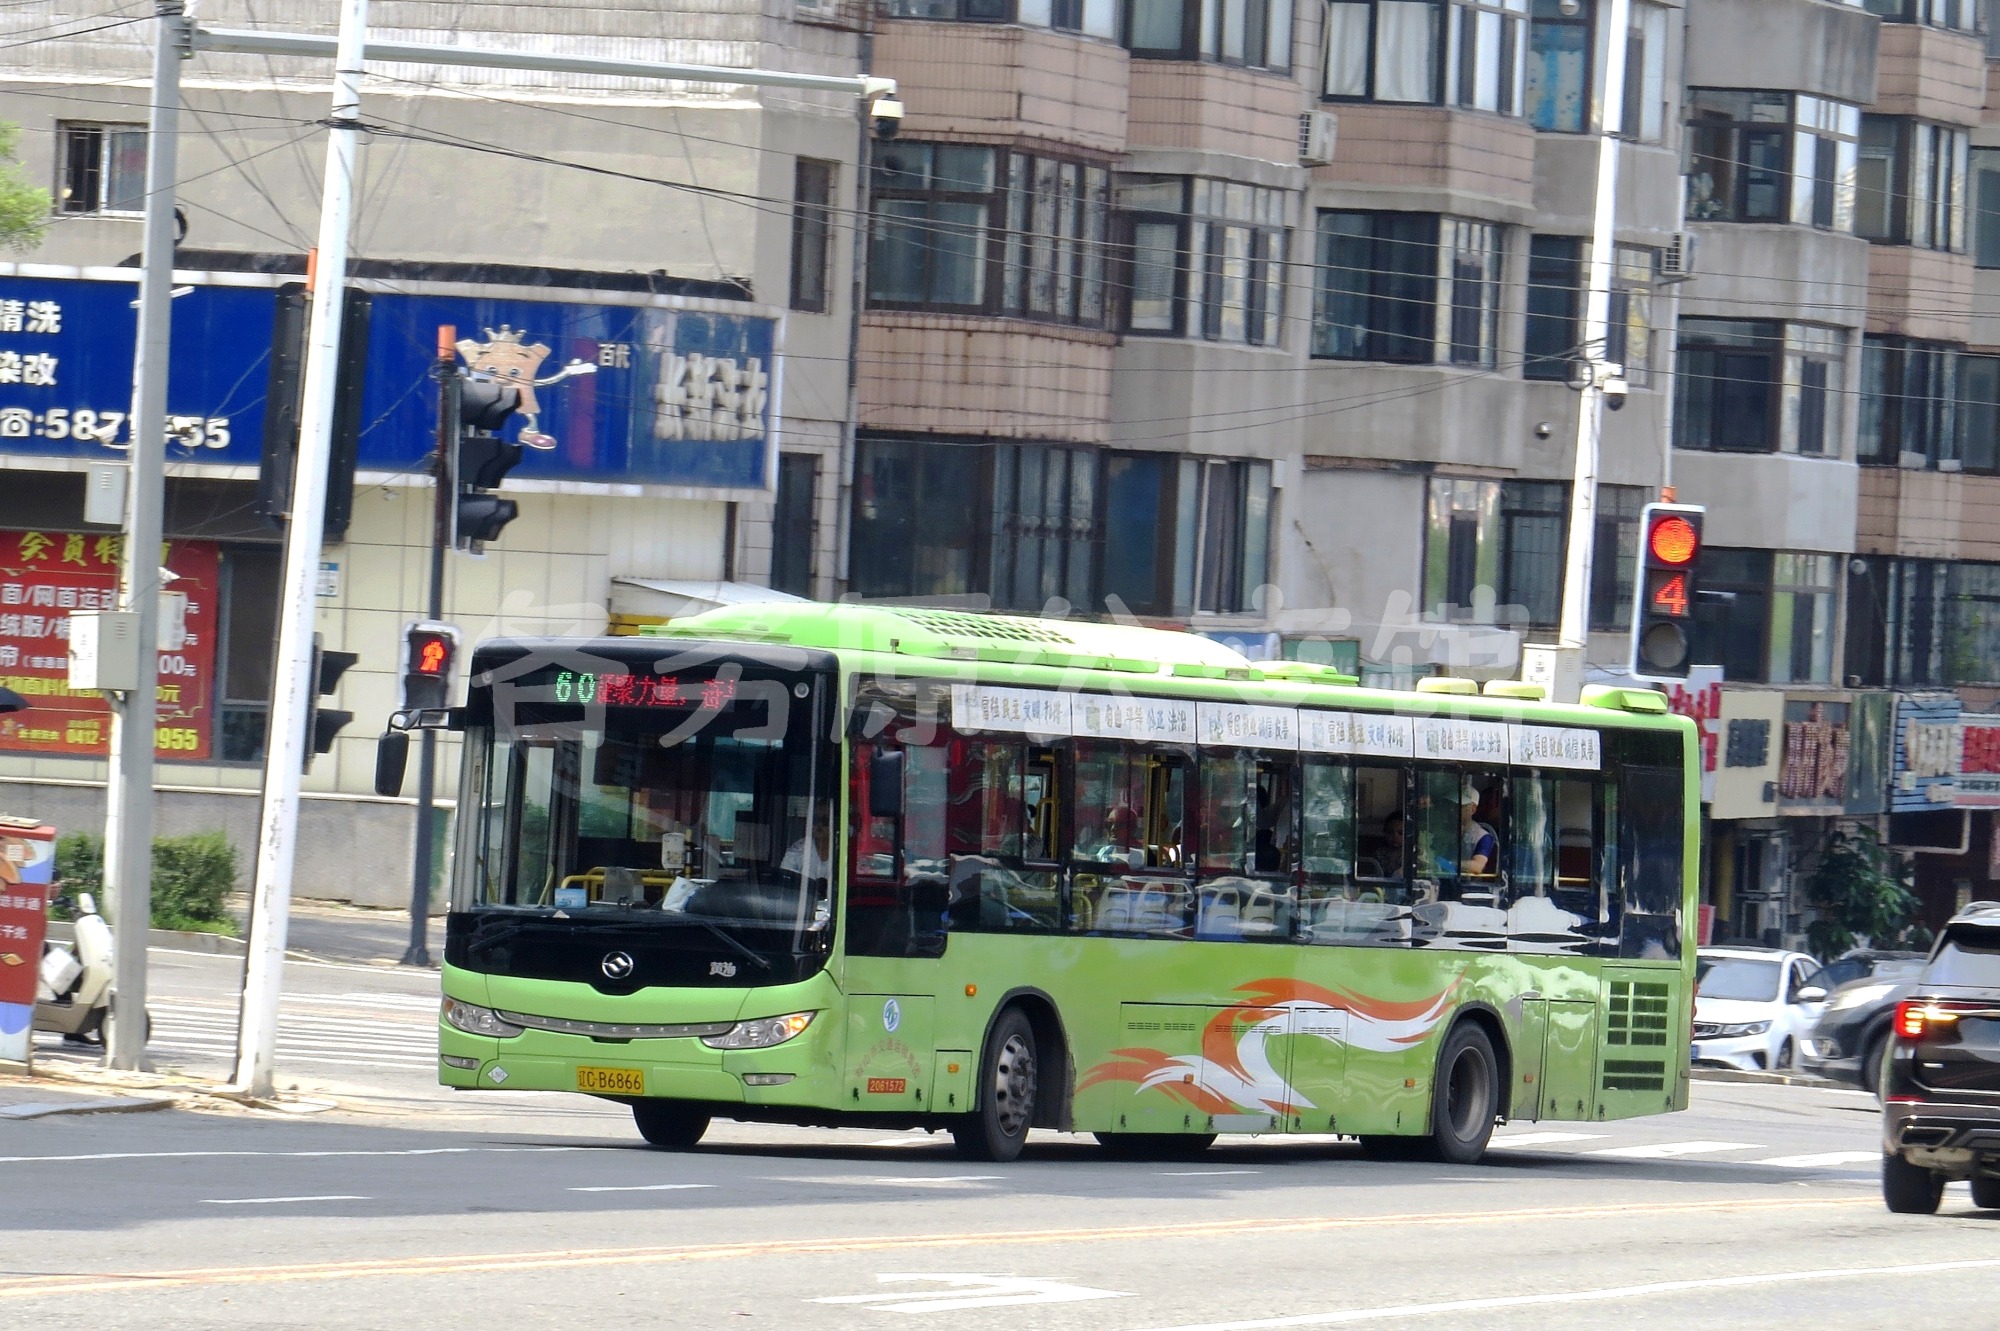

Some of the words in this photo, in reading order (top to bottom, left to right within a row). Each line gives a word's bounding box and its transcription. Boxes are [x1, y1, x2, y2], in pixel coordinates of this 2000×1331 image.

[1656, 574, 1687, 616] 4
[555, 672, 596, 702] 60
[154, 728, 199, 751] 955
[869, 1080, 904, 1092] 2061572
